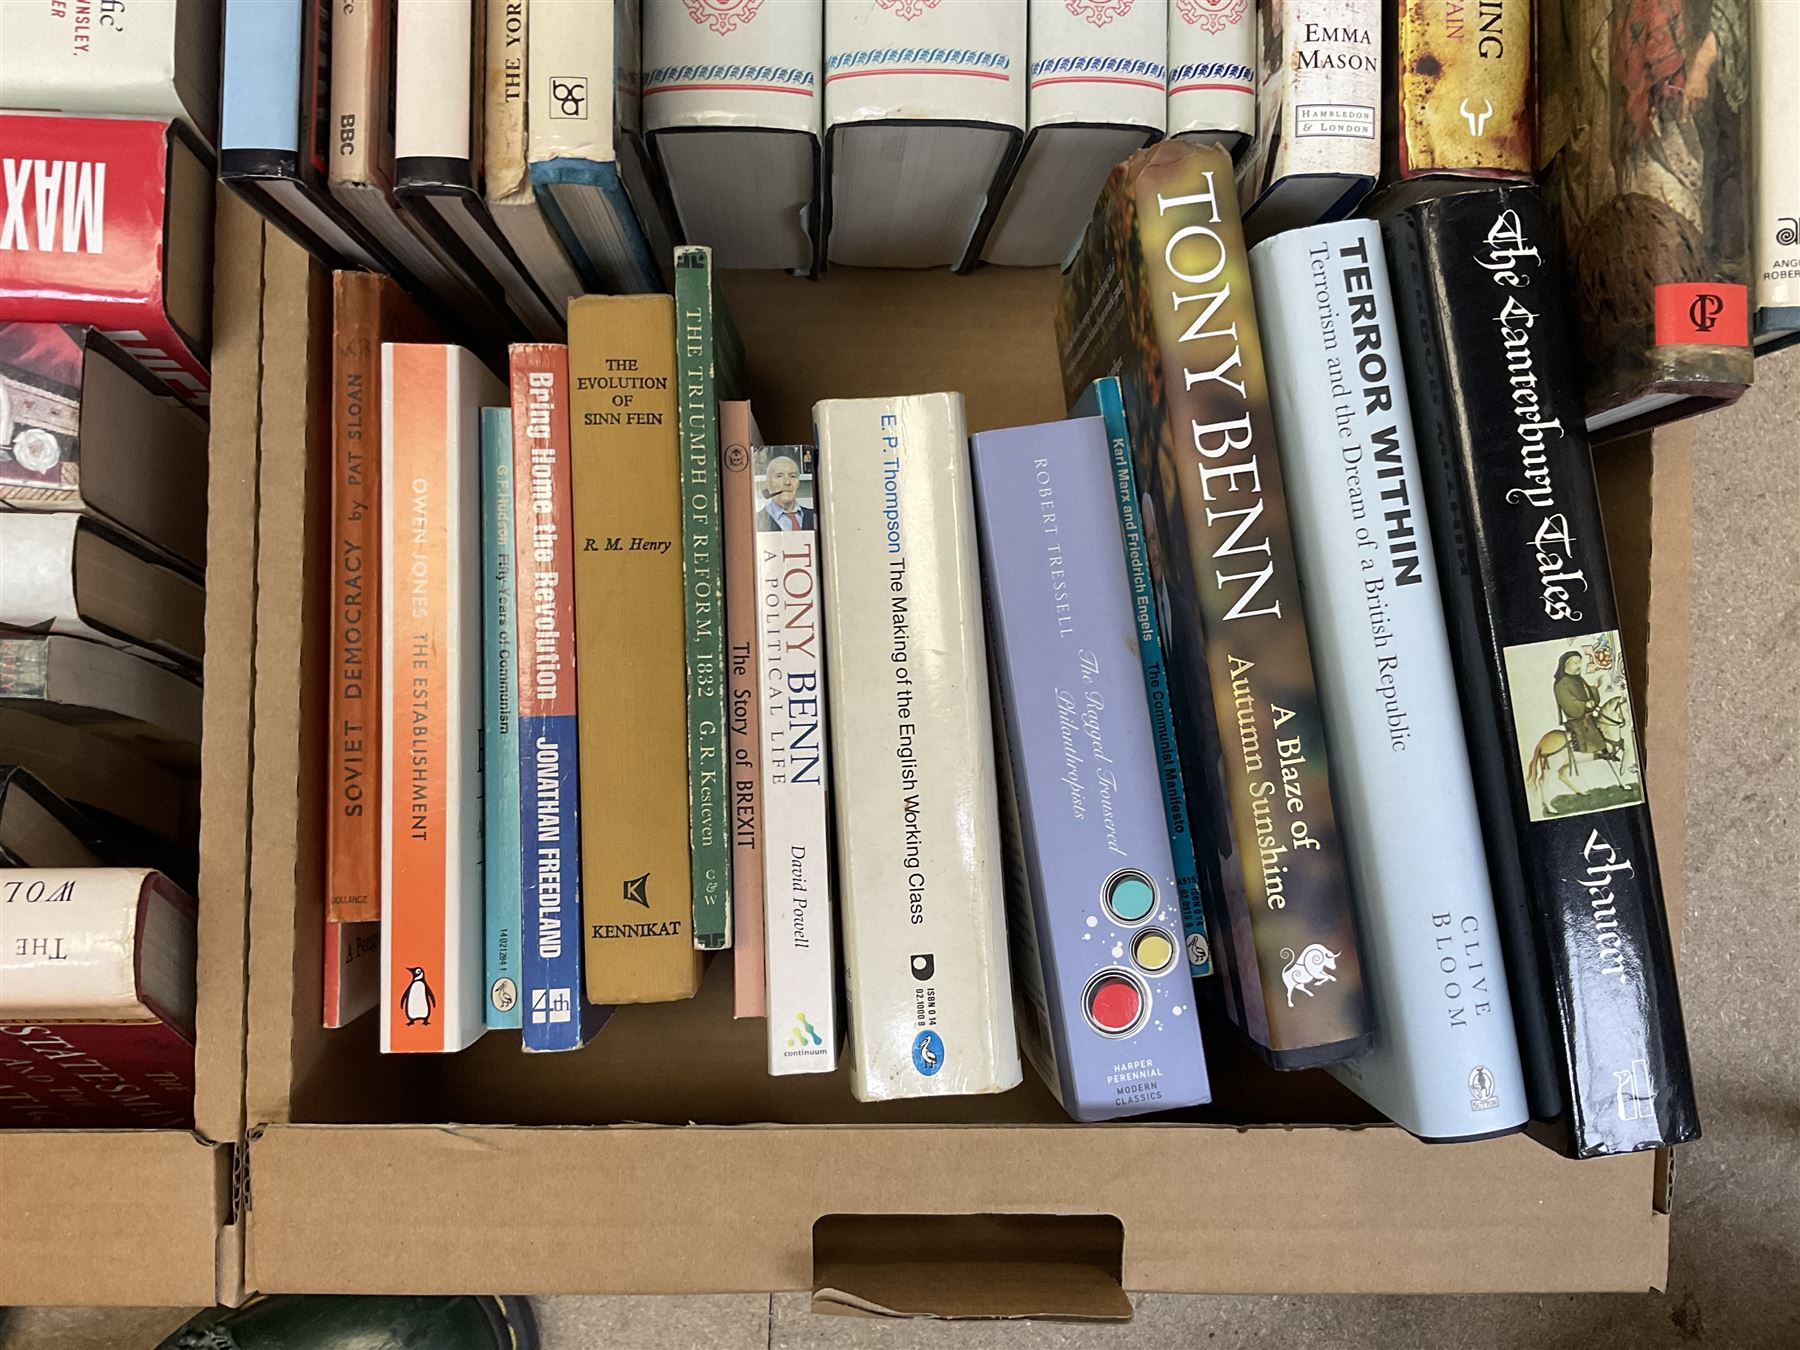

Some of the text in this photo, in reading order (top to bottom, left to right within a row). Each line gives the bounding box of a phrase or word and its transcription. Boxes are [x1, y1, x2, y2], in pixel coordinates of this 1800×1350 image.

[1303, 23, 1372, 45] EMMA
[1446, 0, 1464, 39] AIN
[505, 0, 522, 103] THE YOR
[1297, 50, 1377, 72] MASON
[341, 114, 355, 156] BBC
[1301, 109, 1370, 120] HAMBLEDON
[1302, 122, 1369, 133] & LONDON
[0, 157, 106, 254] MAX
[686, 307, 703, 358] THE
[577, 377, 667, 390] EVOLUTION
[605, 359, 638, 372] THE
[611, 395, 633, 407] OF
[1157, 171, 1282, 621] TONY BENN
[1339, 236, 1393, 416] TERROR
[1370, 424, 1423, 588] WITHIN
[1473, 208, 1589, 623] The Canterbury Tales
[584, 413, 663, 426] SINN FEIN
[688, 366, 707, 485] TRIUMPH
[691, 493, 709, 525] OF
[1309, 241, 1411, 752] Terrorism and the Dream of a British Republic
[528, 372, 561, 700] Bring Home the Revolution
[584, 537, 671, 555] R. M. Henry
[1034, 458, 1073, 639] ROBERT TRESSELL
[496, 553, 510, 580] Fifty
[344, 374, 368, 817] SOVIET DEMOCRACY by PAT SLOAN
[498, 584, 511, 626] Years
[693, 534, 712, 642] REFORM,
[499, 631, 510, 645] of
[1111, 438, 1185, 834] Karl Marx and Friedrich Engels The Communist Manifesto
[411, 478, 428, 841] OWEN JONES THE ESTABLISHMENT
[696, 654, 715, 697] 1832
[764, 550, 787, 785] A POLITICAL LIFE
[782, 543, 821, 786] TONY BENN
[880, 413, 925, 925] E. P. Thompson The Making of the English Working Class
[499, 650, 512, 735] Communism
[732, 641, 755, 850] The Story of BREXIT
[1054, 687, 1086, 820] Philanthropists
[1079, 648, 1128, 856] The Ragged Trousered
[1227, 654, 1288, 911] Autumn Sunshine
[1270, 703, 1320, 850] A Blaze of
[536, 736, 562, 958] JONATHAN FREEDLAND
[4, 880, 77, 903] WOL
[705, 869, 716, 880] C
[705, 882, 718, 893] &
[704, 895, 718, 905] W
[791, 845, 810, 948] David Powell
[15, 938, 68, 960] THE
[592, 921, 681, 939] KENNIKAT
[1431, 911, 1467, 1028] BLOOM
[1460, 915, 1492, 1016] CLIVE
[926, 988, 935, 1008] ISBN
[929, 1017, 936, 1026] 14
[783, 1048, 828, 1057] continuum
[1113, 1059, 1153, 1072] HARPER
[1107, 1068, 1163, 1083] PERENNIAL
[1116, 1082, 1158, 1095] MODERN
[1115, 1091, 1163, 1106] CLASSICS
